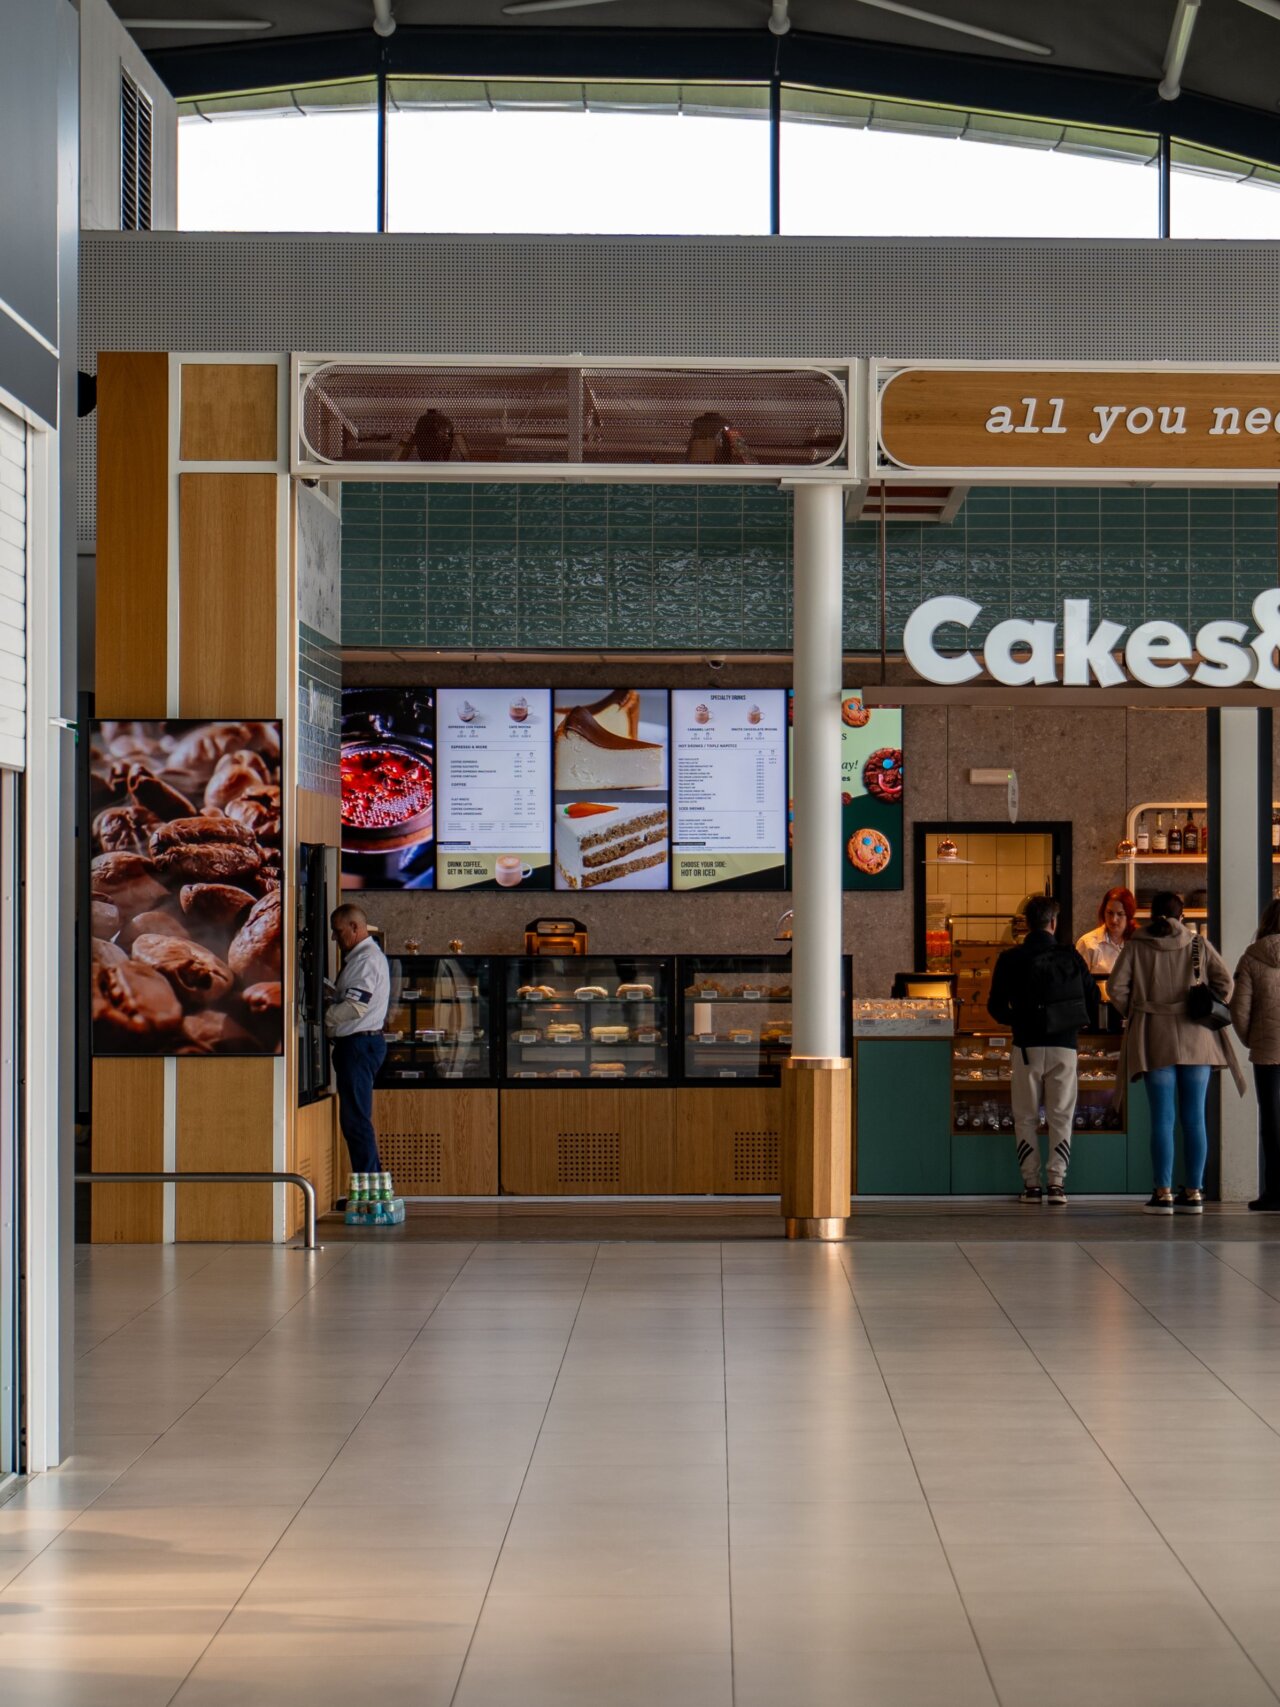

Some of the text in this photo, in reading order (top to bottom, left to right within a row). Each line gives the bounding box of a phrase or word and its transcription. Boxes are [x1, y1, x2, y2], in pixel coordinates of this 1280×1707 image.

[985, 398, 1067, 434] all
[1089, 406, 1187, 444] you
[680, 868, 716, 877] HOT OR ICED
